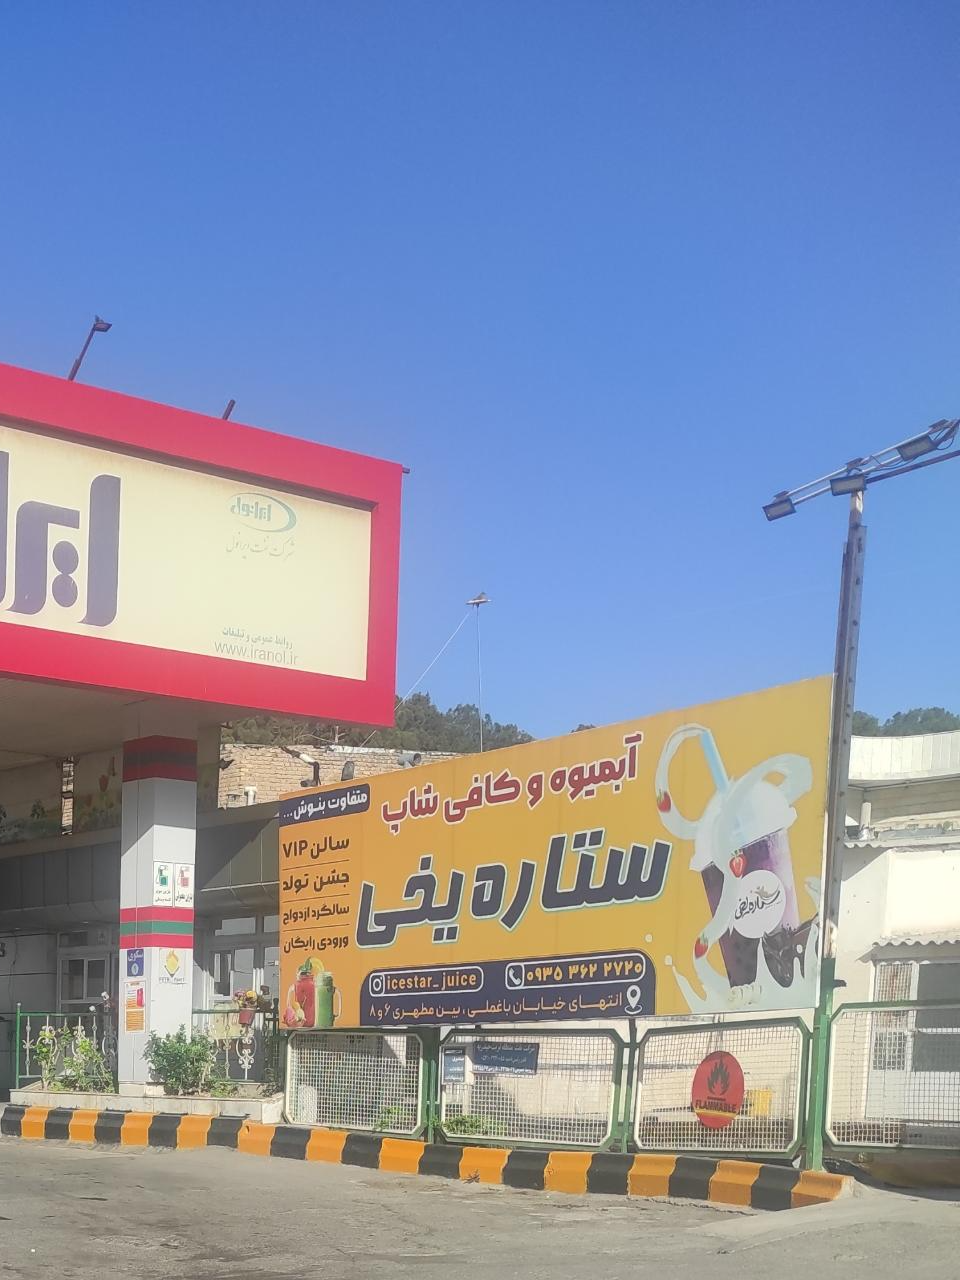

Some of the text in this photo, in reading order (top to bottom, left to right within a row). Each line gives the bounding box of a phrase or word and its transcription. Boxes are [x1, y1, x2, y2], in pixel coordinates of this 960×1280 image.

[214, 641, 299, 665] www.iranol.ir
[382, 732, 642, 834] آبمیوه و کافی شاپ
[328, 791, 368, 812] متفاوت
[283, 836, 349, 859] سالن VIP
[283, 869, 349, 894] جشن تولد
[357, 829, 671, 948] ستاره یخی
[283, 903, 349, 925] سالگرد ازدواج
[283, 935, 348, 953] ورودی رایگان
[393, 1002, 434, 1019] مطهری
[436, 1002, 460, 1018] بین
[513, 996, 566, 1014] خیابان
[568, 992, 622, 1012] انتهای
[696, 1099, 737, 1113] FLAMMABLE
